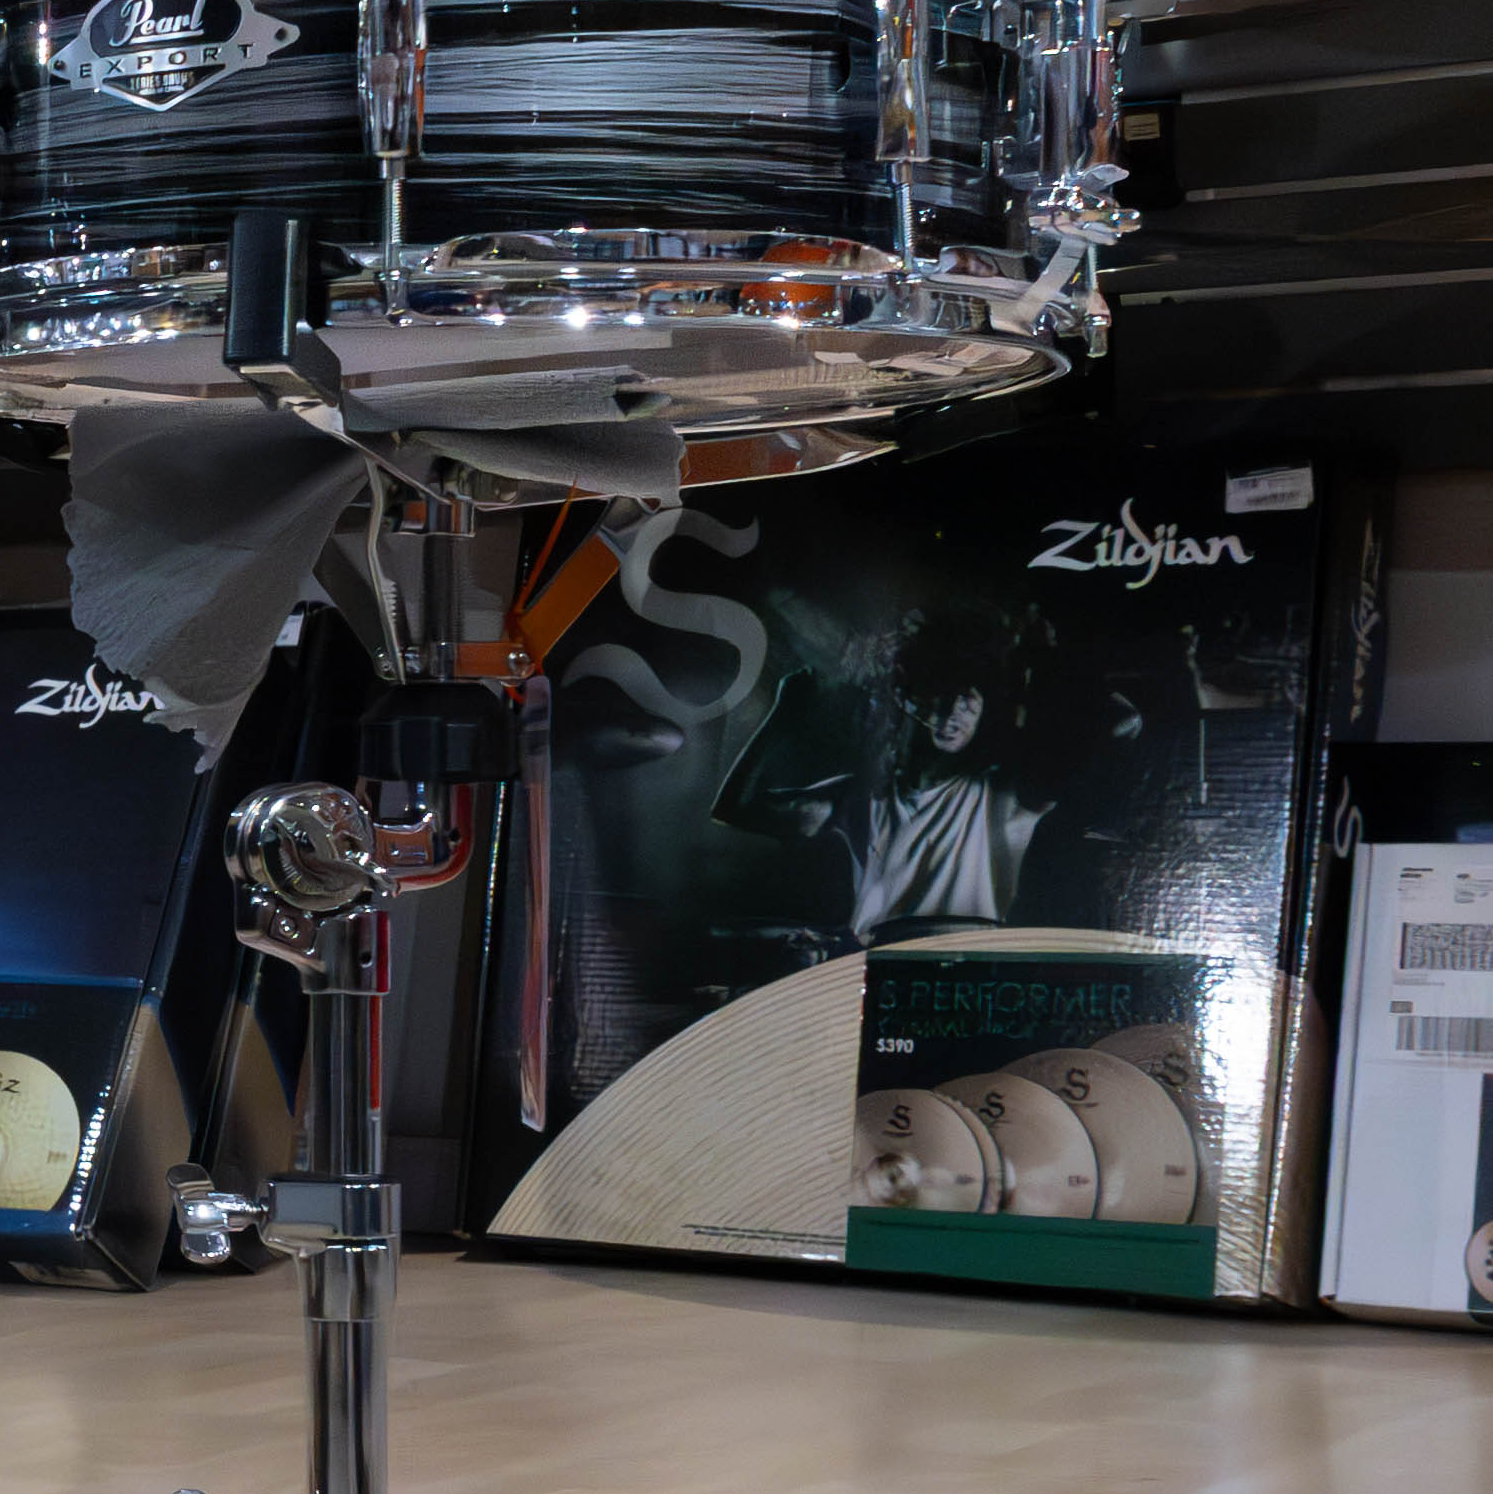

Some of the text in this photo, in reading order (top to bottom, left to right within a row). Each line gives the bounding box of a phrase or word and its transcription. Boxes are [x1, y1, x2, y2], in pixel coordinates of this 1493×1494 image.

[79, 42, 255, 78] EXPORT
[1027, 497, 1255, 590] Zildjian
[15, 663, 165, 729] Zildjian
[875, 1038, 915, 1054] S390
